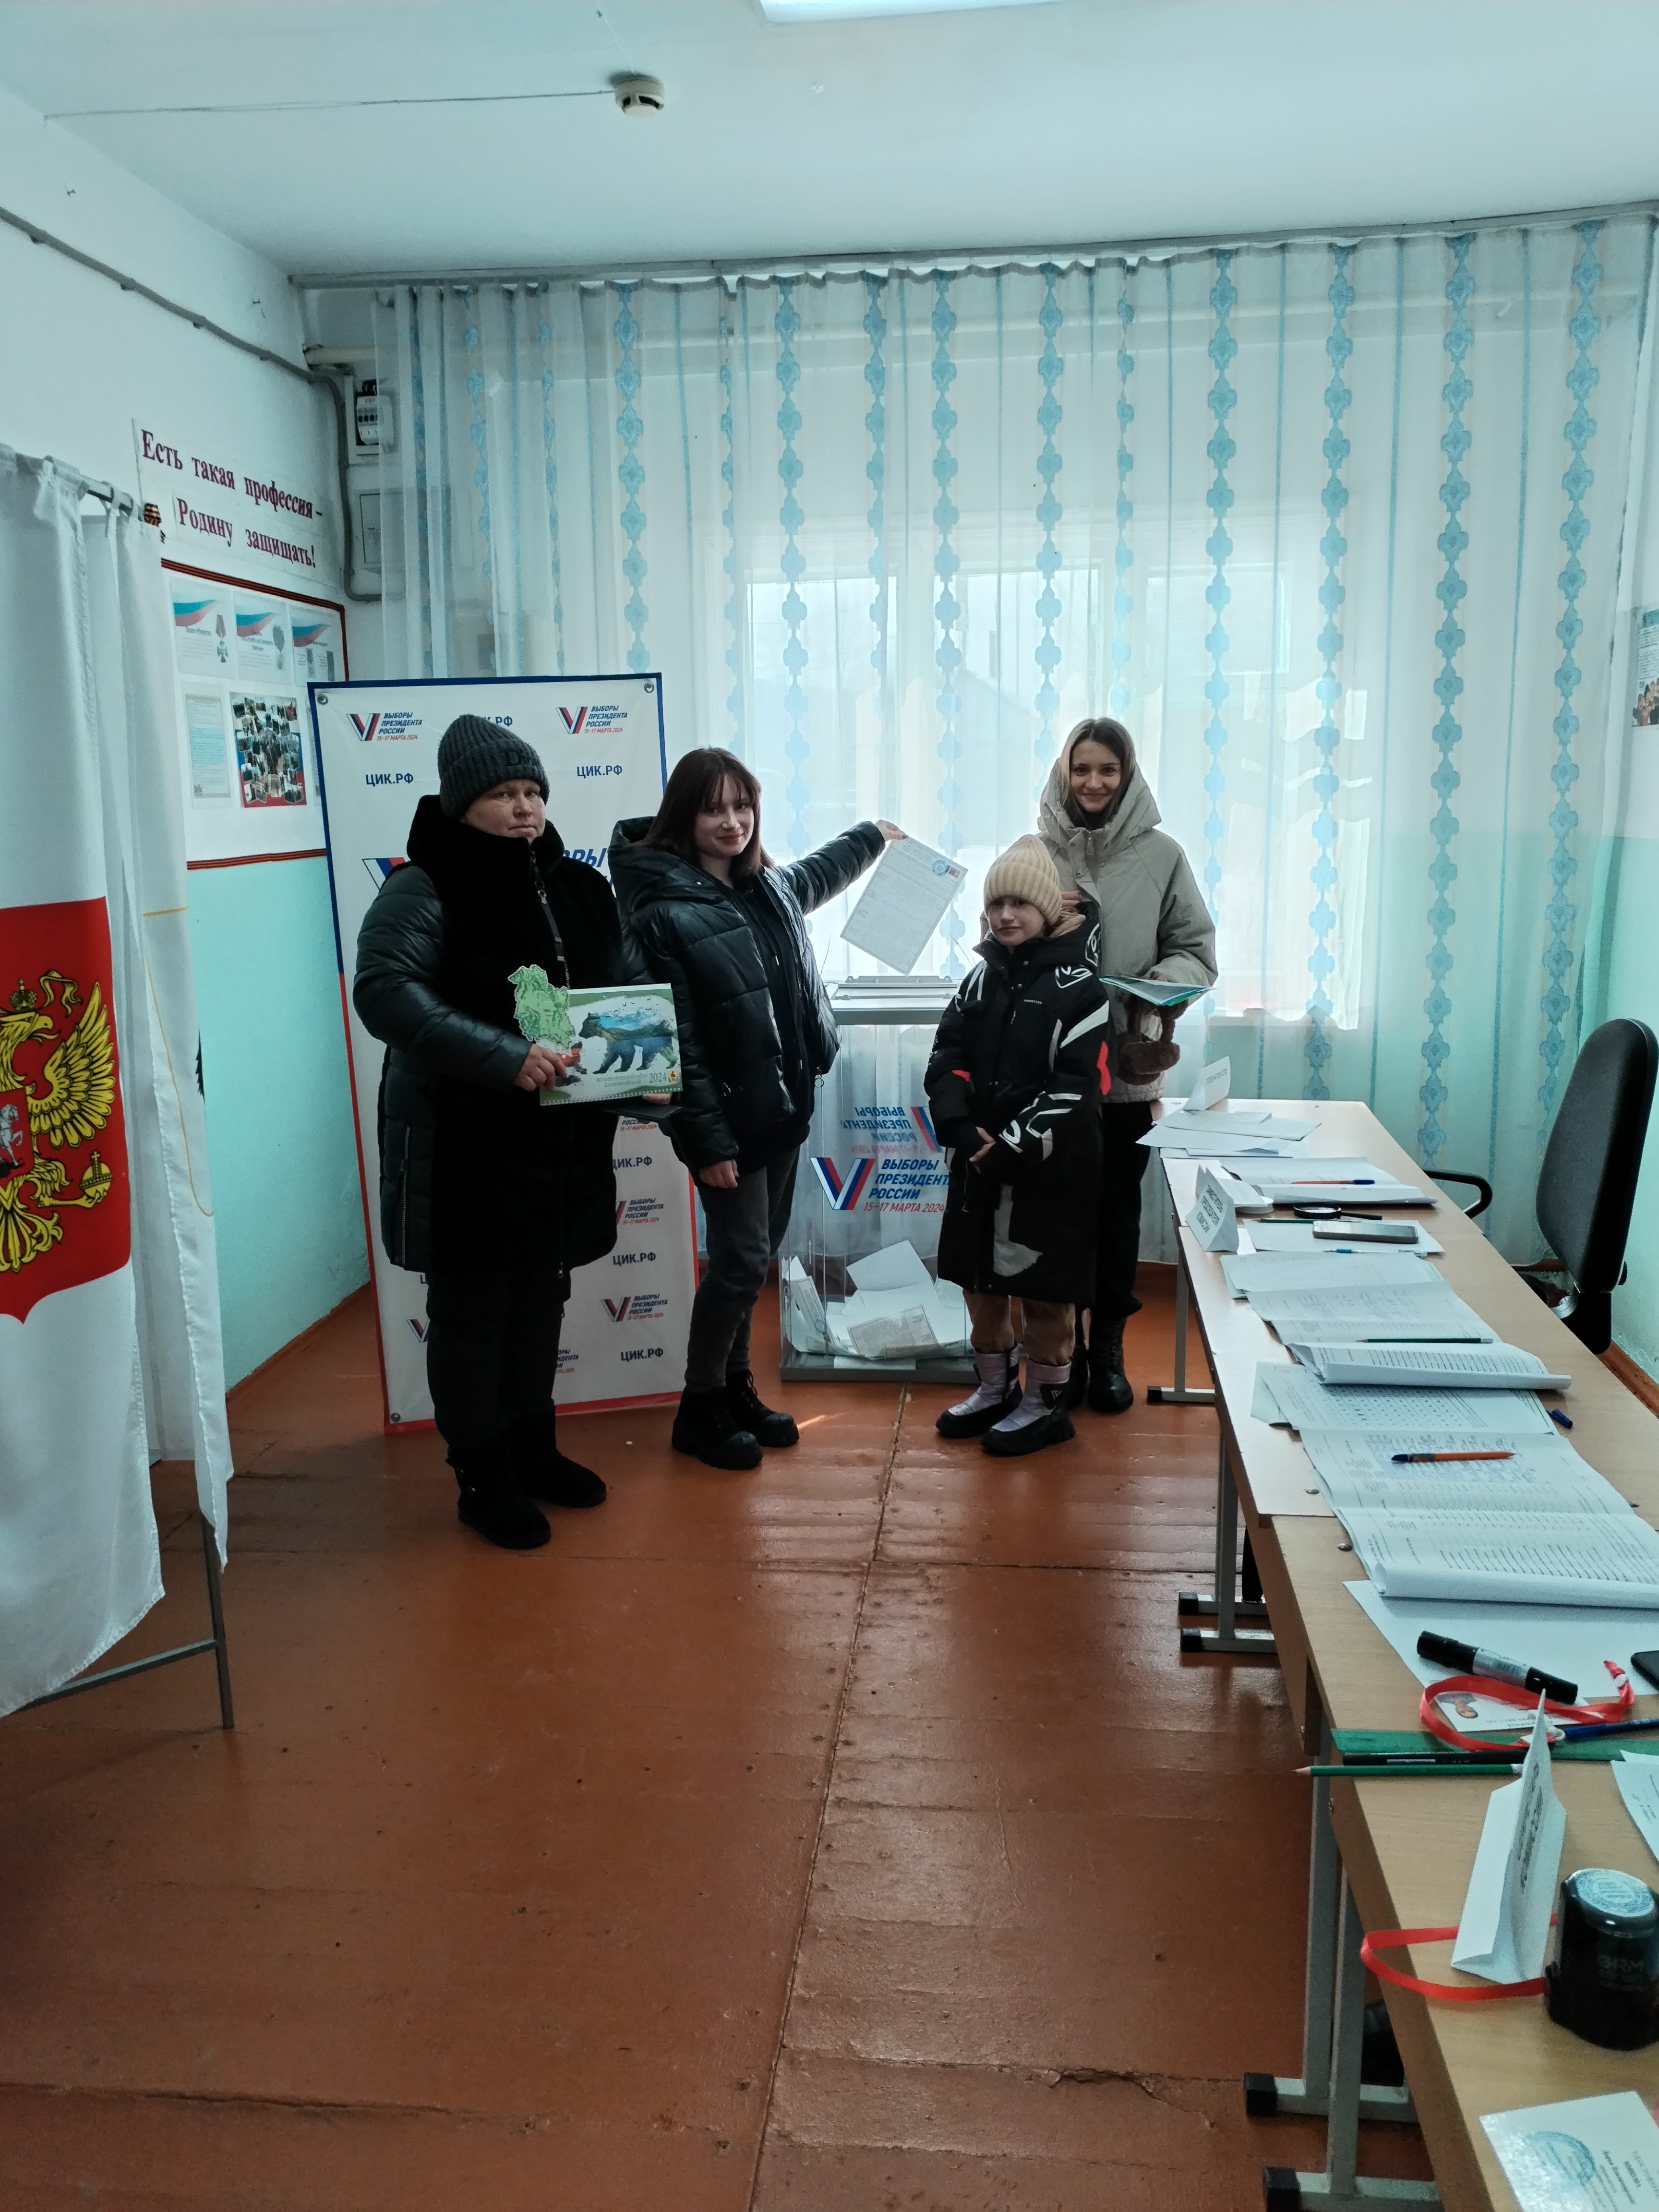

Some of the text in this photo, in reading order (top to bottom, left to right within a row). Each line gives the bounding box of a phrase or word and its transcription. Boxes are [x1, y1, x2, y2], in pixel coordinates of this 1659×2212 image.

[141, 428, 183, 470] Есть
[191, 457, 236, 490] такая
[176, 497, 316, 568] Родину защищать!
[577, 764, 623, 779] ЦИК.РФ
[365, 772, 414, 787] ЦИК.РФ
[649, 1072, 667, 1083] 2024
[881, 1158, 939, 1170] ВЫБОРЫ
[875, 1173, 949, 1187] ПРЕЗИДЕНТ
[868, 1188, 921, 1200] РОССИИ
[627, 1203, 664, 1212] ПРЕЗИДЕНТА
[889, 1202, 921, 1213] МАРТА
[921, 1202, 945, 1213] 2024
[613, 1251, 657, 1267] ЦИК.РФ
[631, 1299, 668, 1308] ПРЕЗИДЕНТА
[621, 1347, 664, 1362] ЦИК.РФ
